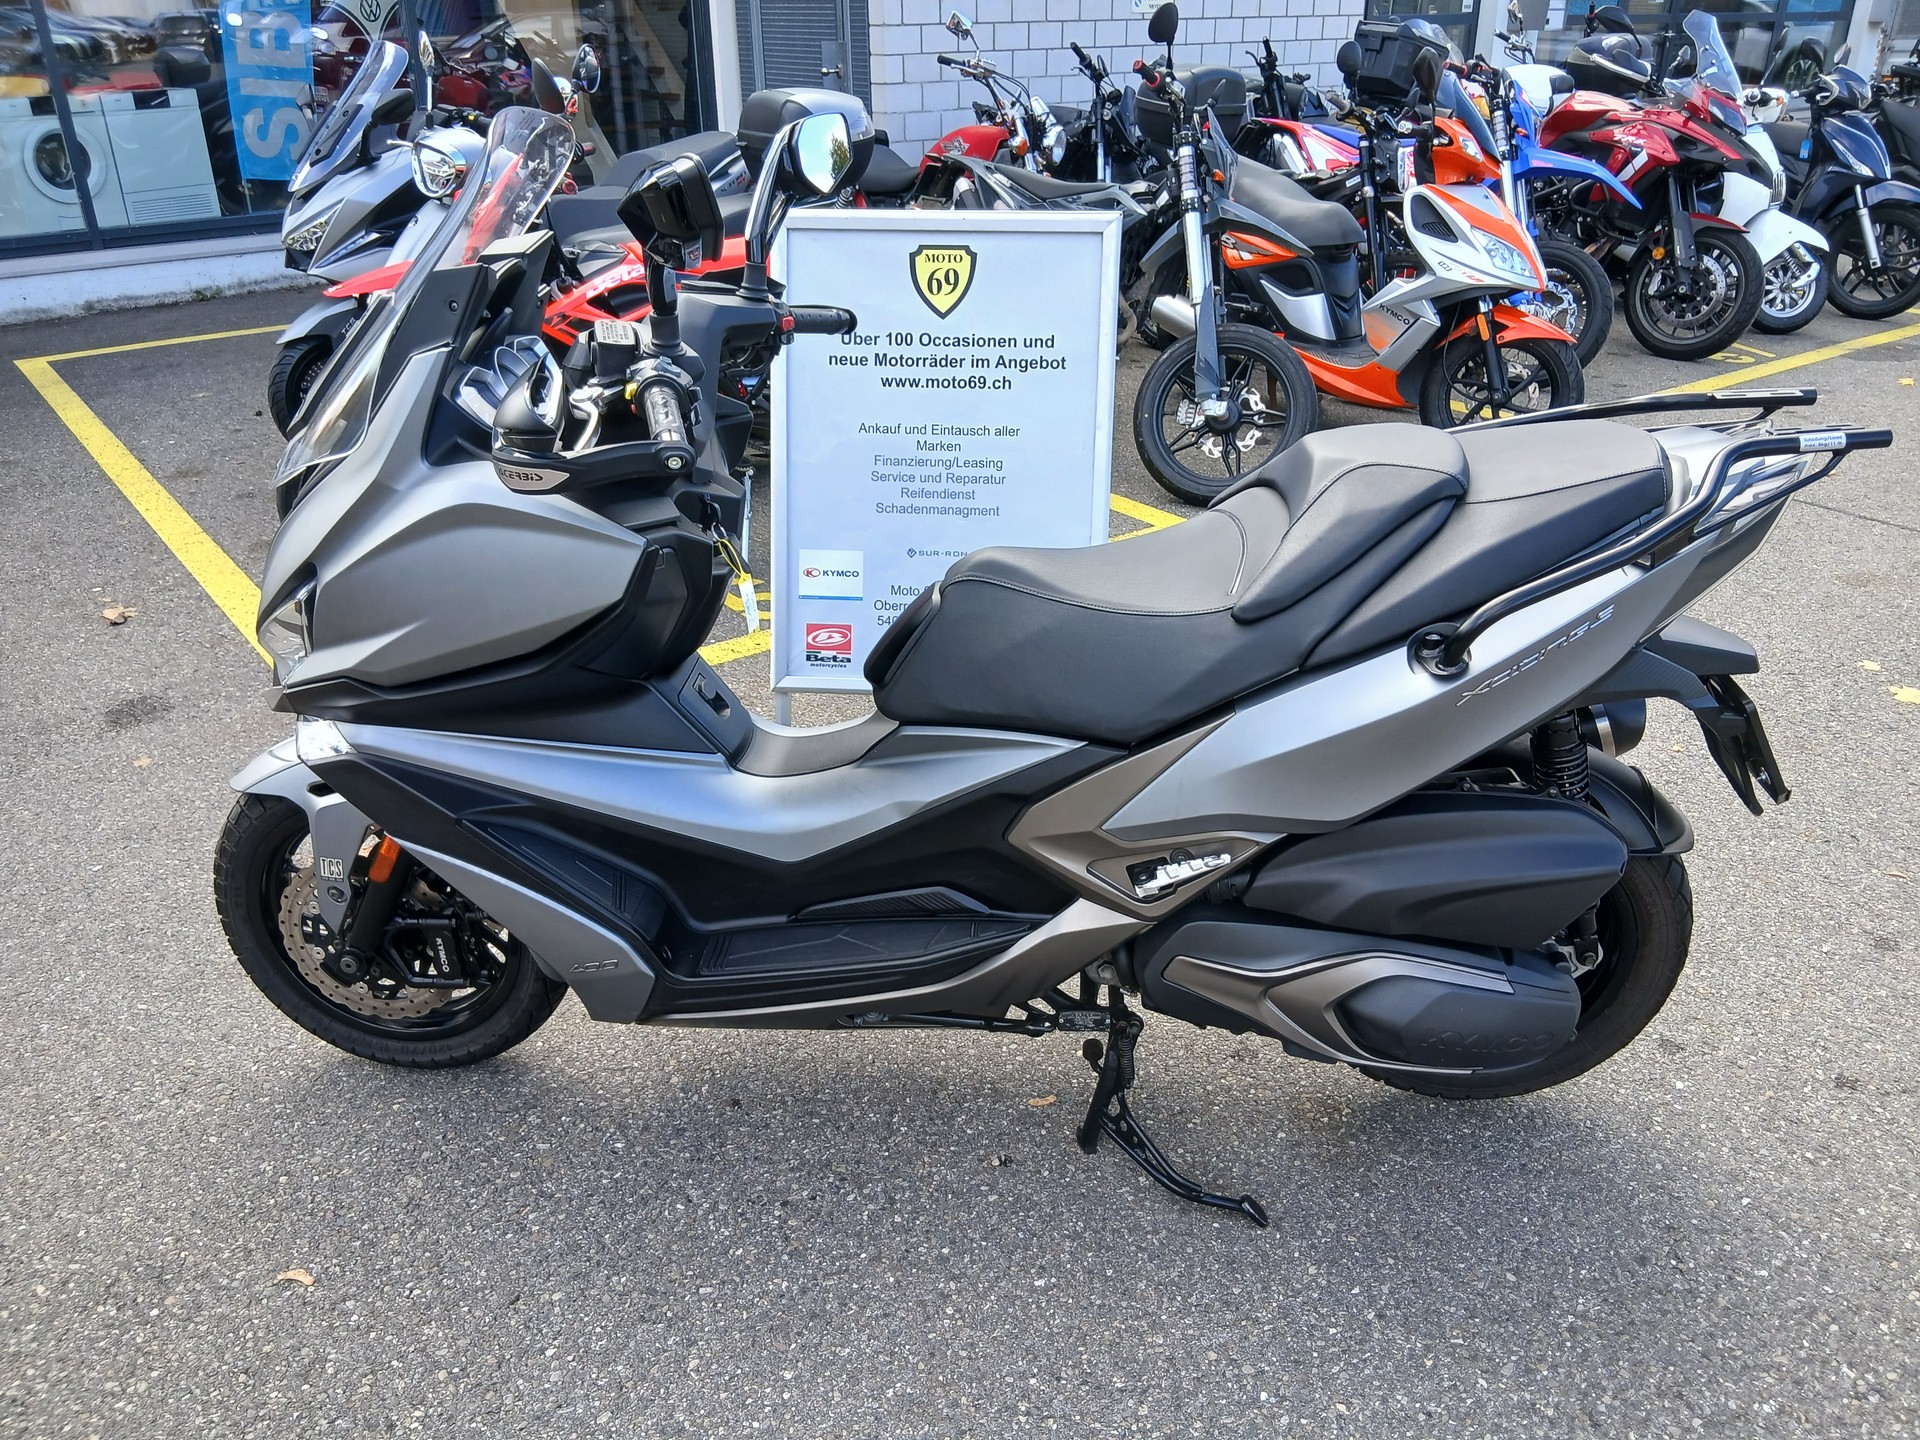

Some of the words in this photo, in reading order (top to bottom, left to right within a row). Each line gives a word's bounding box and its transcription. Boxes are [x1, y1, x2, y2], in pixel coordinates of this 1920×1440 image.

[924, 253, 963, 264] MOTO
[927, 267, 960, 297] 69
[1379, 303, 1411, 326] KYMCO
[886, 332, 914, 347] 100
[919, 332, 1018, 349] Occasionen
[1024, 334, 1055, 349] und
[828, 354, 869, 367] neue
[874, 352, 966, 369] Motorräder
[971, 354, 990, 369] im
[995, 355, 1067, 373] Angebot
[880, 375, 1012, 391] www.moto69.ch
[858, 422, 902, 435] Ankauf
[904, 423, 927, 436] und
[931, 423, 991, 437] Eintausch
[994, 425, 1021, 438] aller
[916, 439, 961, 452] Marken
[873, 455, 1004, 472] Finanzierung/Leasing
[870, 470, 916, 483] Service
[919, 471, 942, 484] und
[945, 471, 1007, 487] Reparatur
[900, 486, 976, 501] Reifendienst
[875, 502, 1000, 518] Schadenmanagment
[822, 569, 860, 578] KYMCO
[890, 584, 920, 597] Moto
[873, 599, 909, 612] Oberr
[805, 653, 852, 664] Beta
[320, 858, 344, 878] TCS
[435, 937, 450, 973] KYMCO
